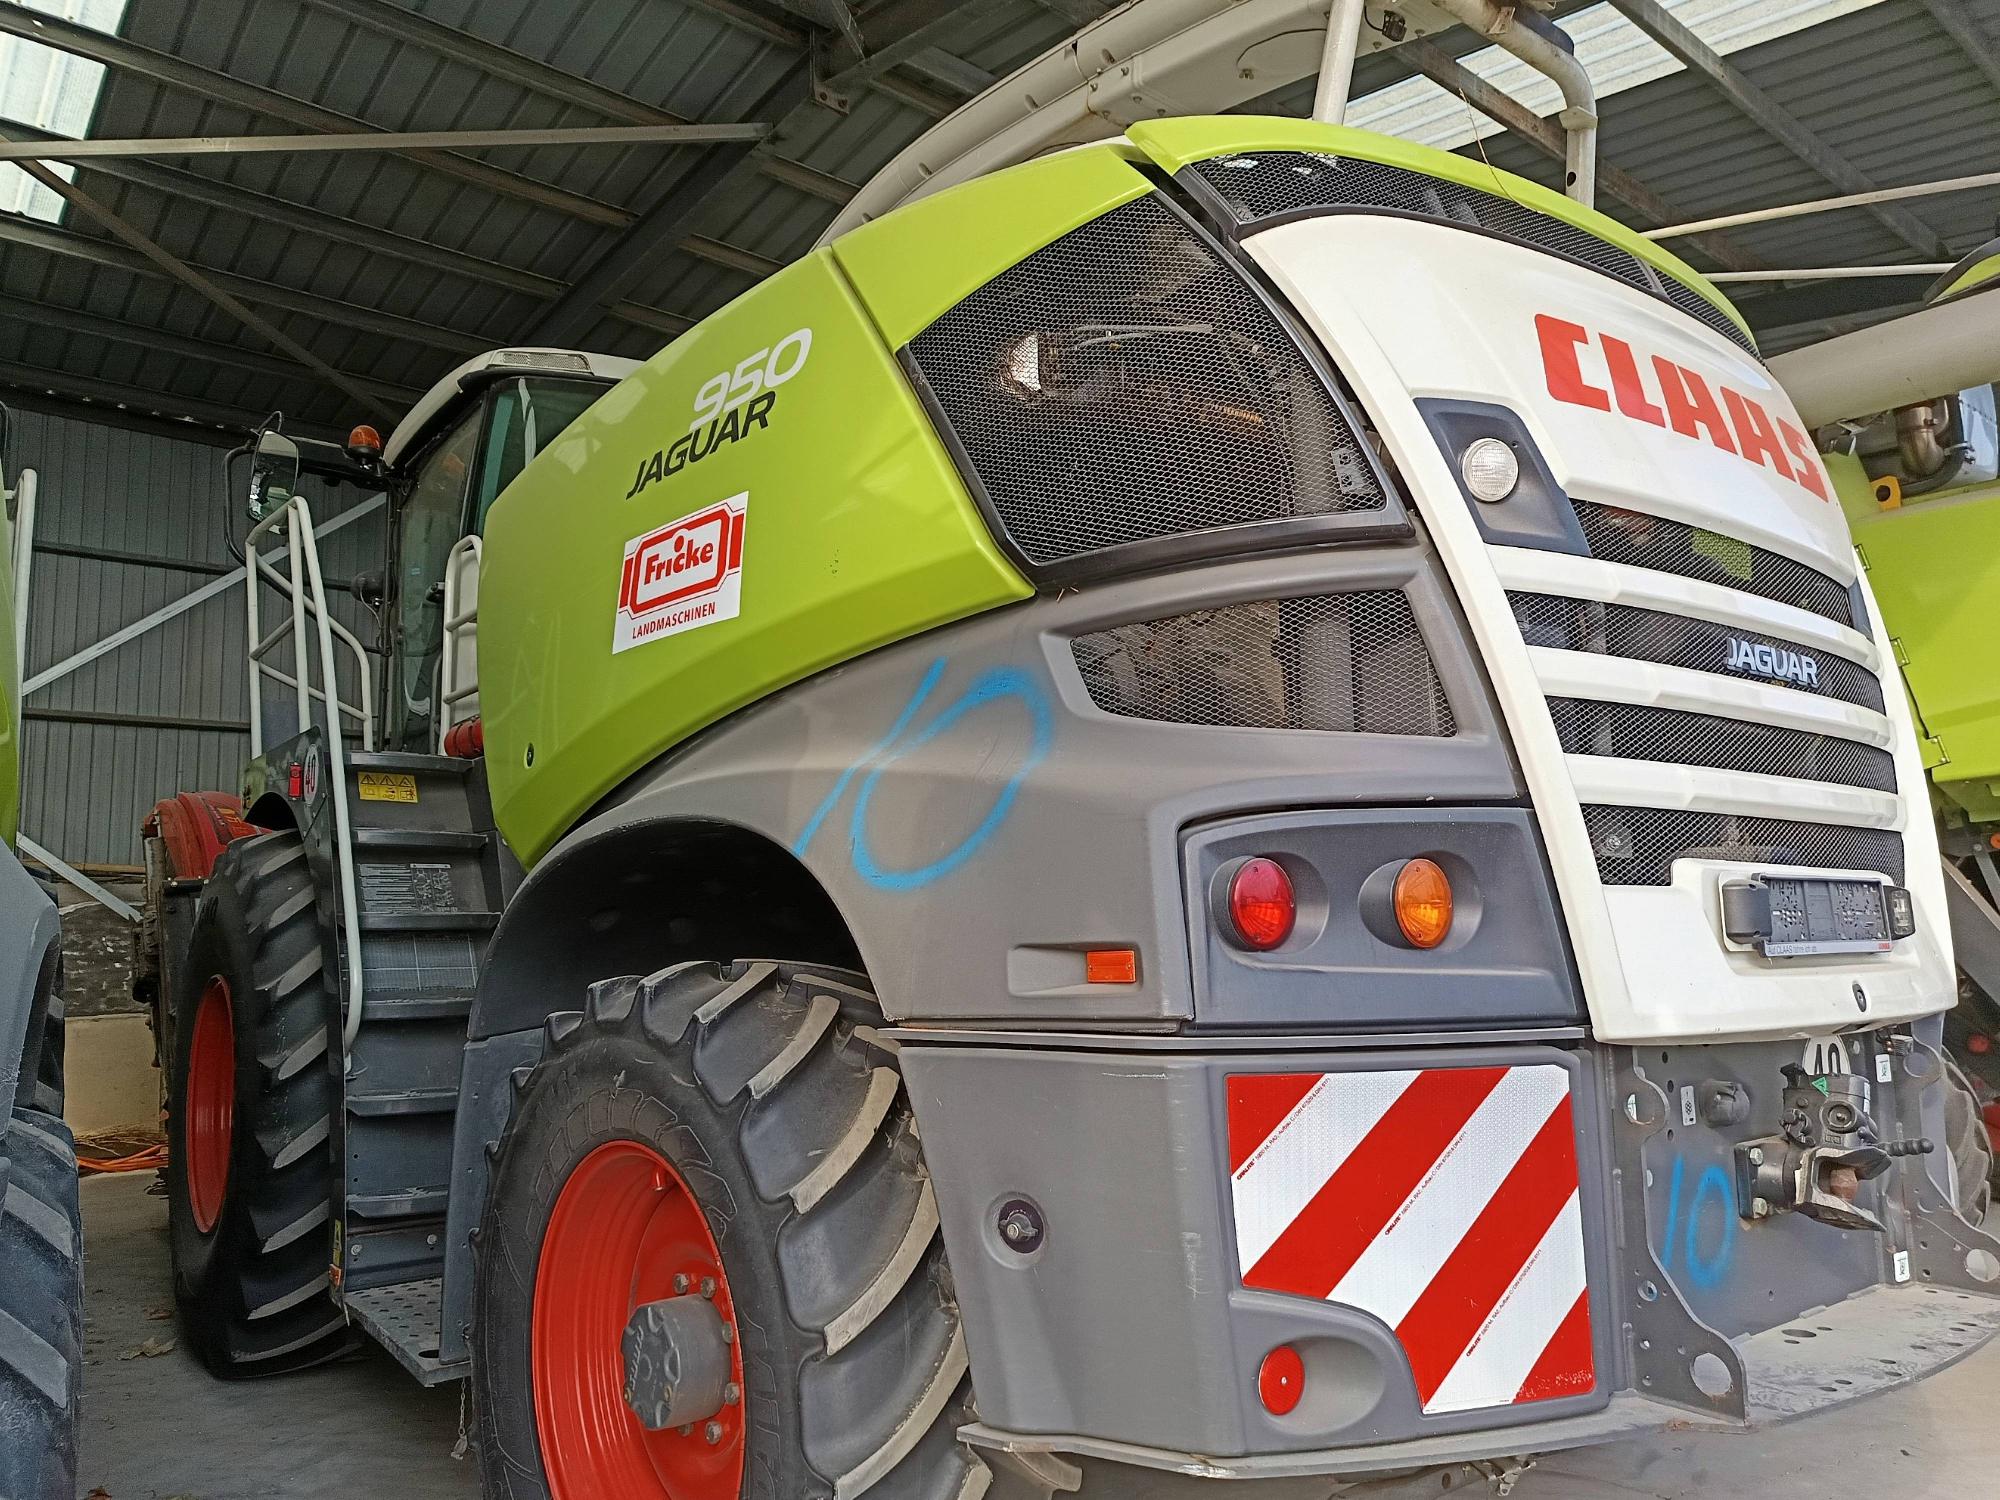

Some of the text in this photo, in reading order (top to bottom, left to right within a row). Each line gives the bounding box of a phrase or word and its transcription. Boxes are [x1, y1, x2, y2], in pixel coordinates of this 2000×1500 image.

[689, 328, 813, 431] 950
[1534, 313, 1828, 502] CLAAS
[626, 391, 776, 499] JAGUAR
[644, 535, 714, 585] Fricke
[632, 601, 716, 639] LANDMASCHINEN
[1726, 636, 1819, 686] JAGUAR
[792, 656, 1056, 892] 10
[1660, 1152, 1737, 1291] 10
